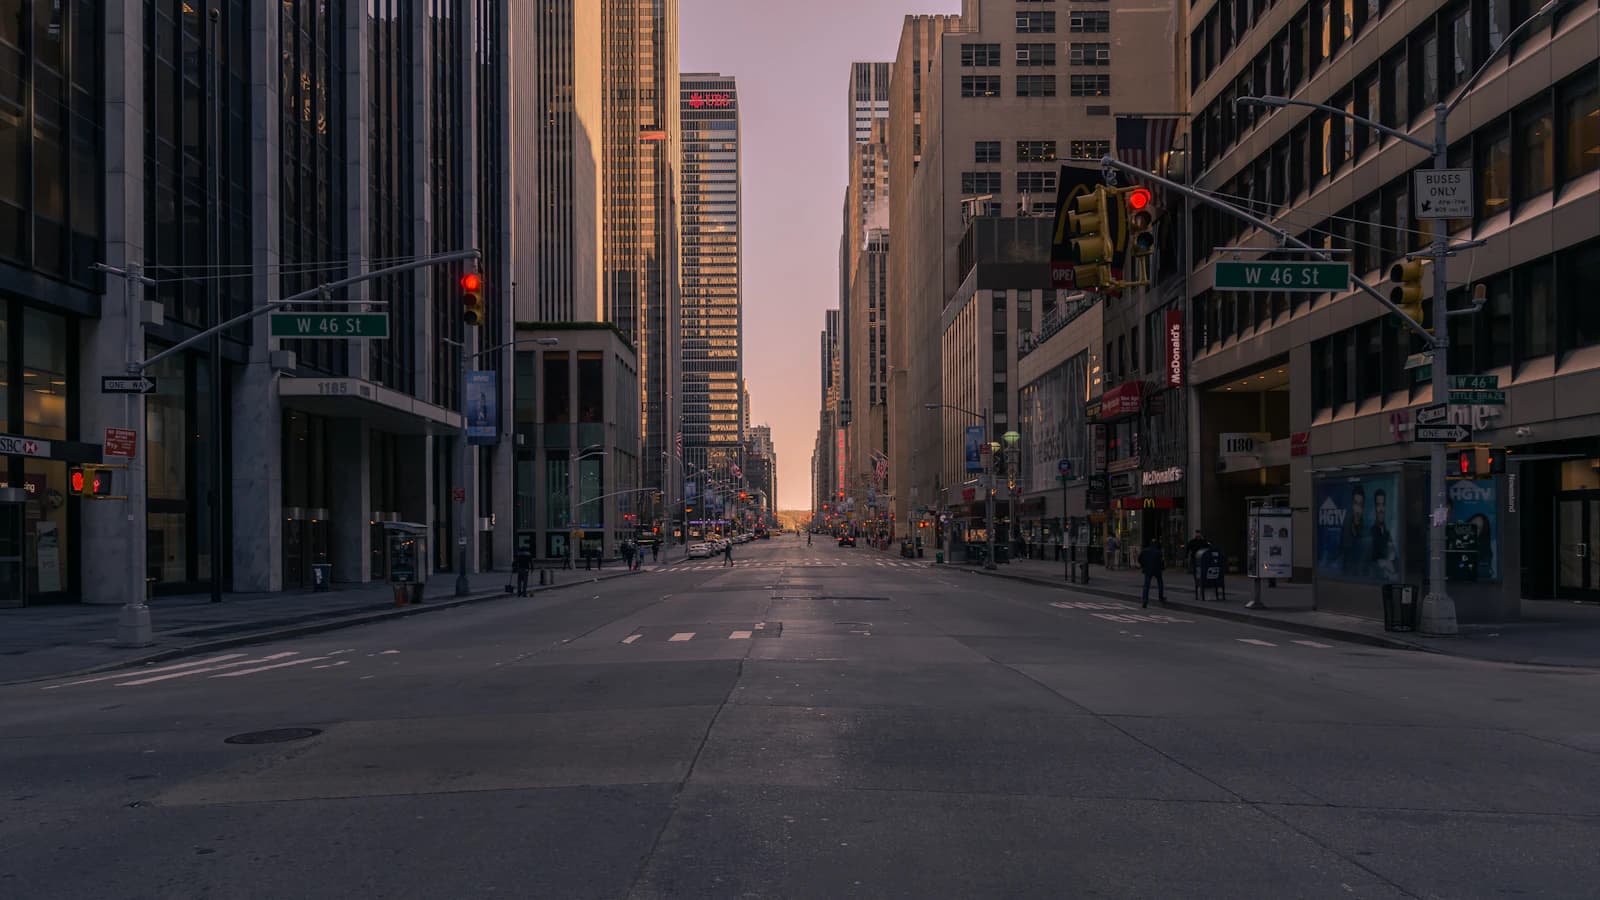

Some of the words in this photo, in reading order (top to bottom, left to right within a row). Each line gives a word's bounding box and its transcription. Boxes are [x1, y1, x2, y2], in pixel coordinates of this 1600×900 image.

[705, 94, 730, 106] UBS
[1426, 174, 1461, 184] BUSES
[1430, 187, 1457, 196] ONLY
[1245, 266, 1261, 284] W
[1270, 267, 1293, 285] 46
[1301, 267, 1320, 285] St
[296, 317, 311, 333] W
[319, 318, 339, 333] 46
[346, 318, 362, 333] St
[1170, 323, 1181, 385] McDonald's
[318, 382, 348, 394] 1185
[1457, 377, 1466, 388] W
[1471, 377, 1487, 388] 46
[1422, 430, 1440, 438] ONE
[1447, 430, 1465, 438] WAY
[1226, 438, 1253, 452] 1180
[1142, 466, 1182, 486] McDonald's
[1449, 487, 1492, 501] HGTV
[1318, 509, 1347, 526] HGTV
